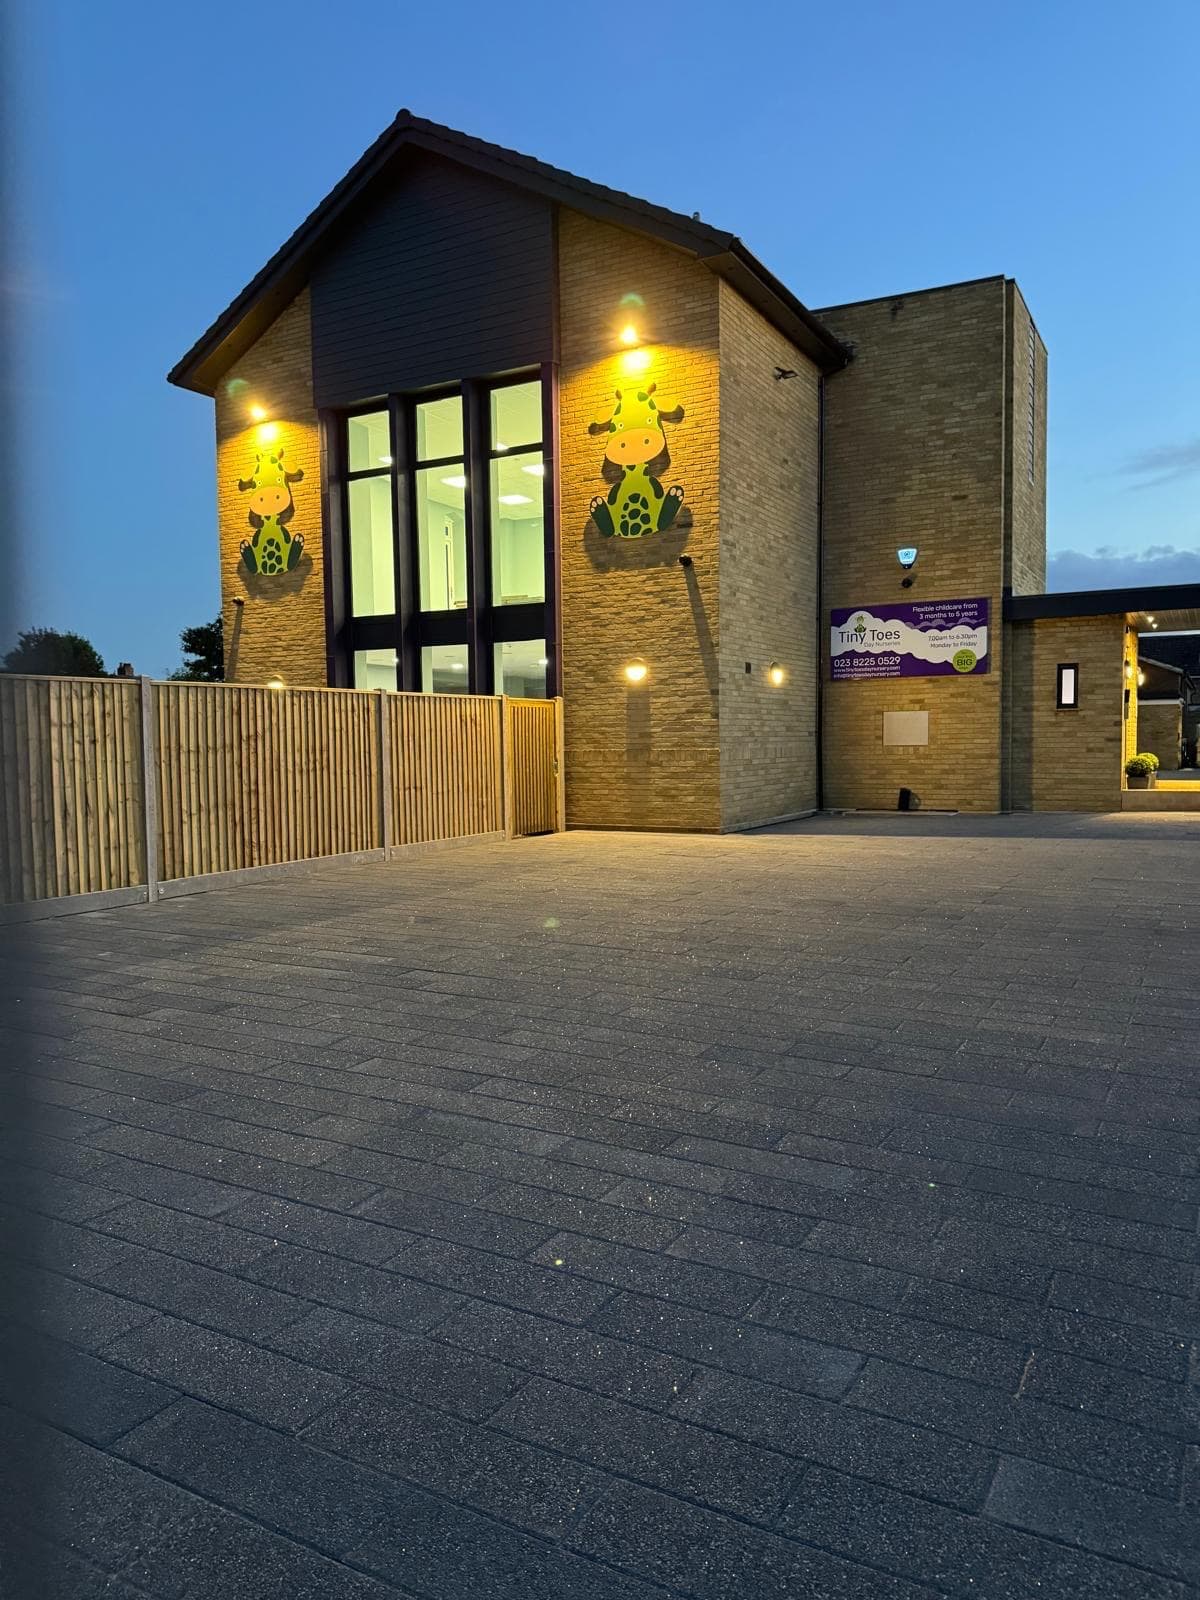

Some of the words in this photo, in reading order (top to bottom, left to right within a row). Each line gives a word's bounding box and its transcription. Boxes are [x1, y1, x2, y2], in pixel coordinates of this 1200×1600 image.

[838, 630, 867, 645] Tiny
[869, 629, 901, 641] Toes
[834, 658, 851, 667] 023
[853, 657, 876, 667] 8225
[877, 656, 901, 666] 0529
[956, 658, 973, 666] BIG
